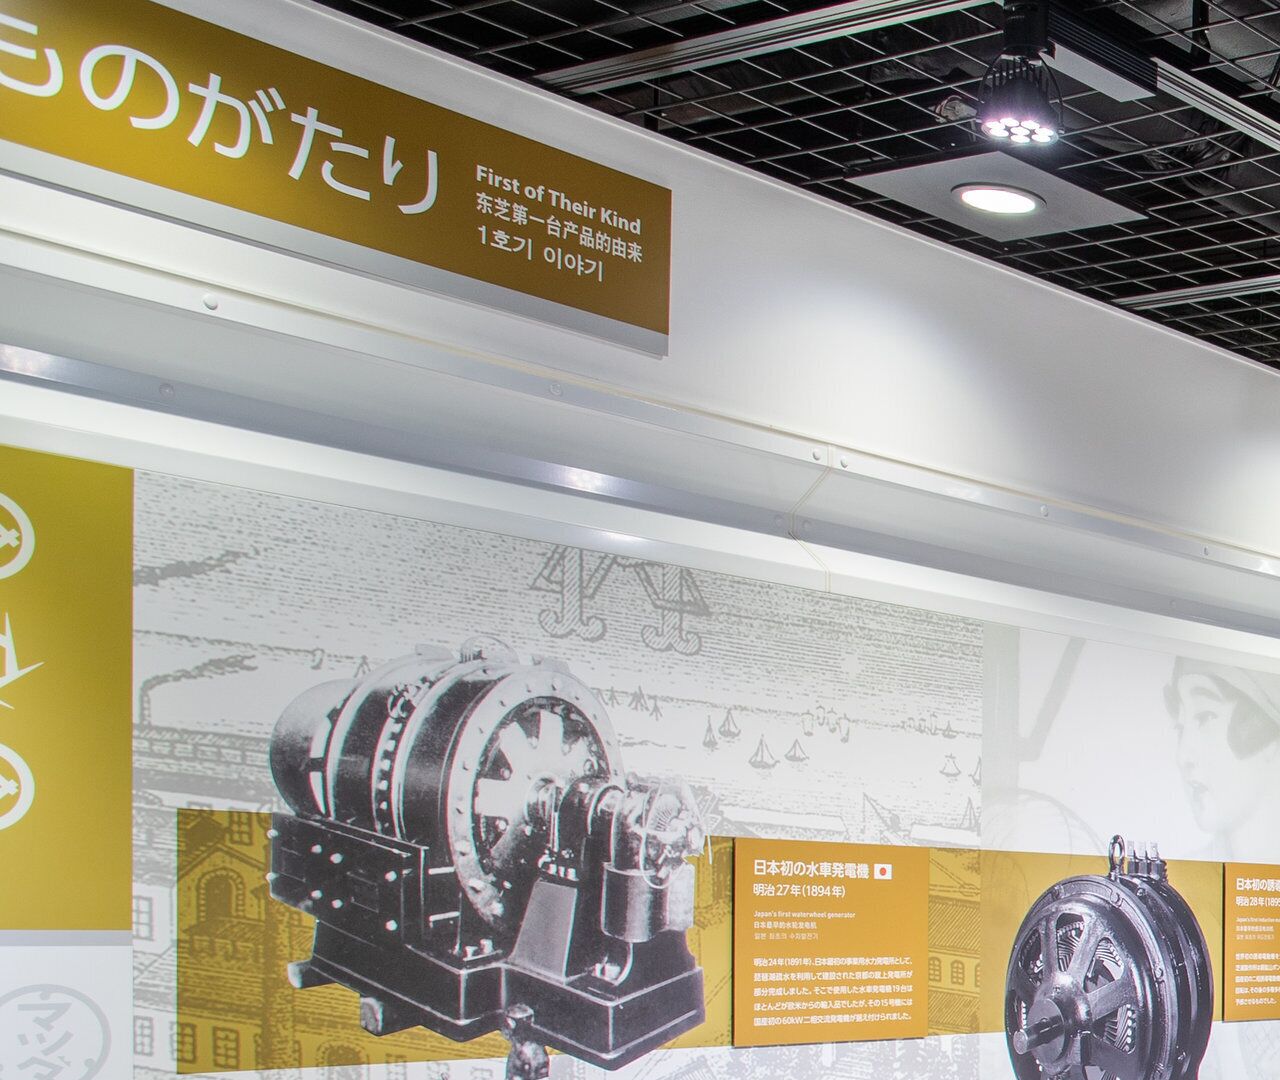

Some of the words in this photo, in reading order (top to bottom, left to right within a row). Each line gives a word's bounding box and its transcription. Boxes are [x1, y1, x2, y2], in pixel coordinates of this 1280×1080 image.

[0, 13, 439, 215] ものがたり
[476, 164, 520, 195] First
[524, 185, 545, 202] of
[549, 189, 597, 219] Their
[601, 207, 641, 235] Kind
[476, 192, 643, 263] 东芝第一台产品的由来
[478, 225, 532, 260] 1호기
[543, 247, 603, 282] 이야기
[753, 884, 846, 898] 明治27年(1894年)
[754, 859, 870, 879] 日本初の水車発電機
[753, 910, 776, 919] Japan's
[827, 911, 856, 919] generator
